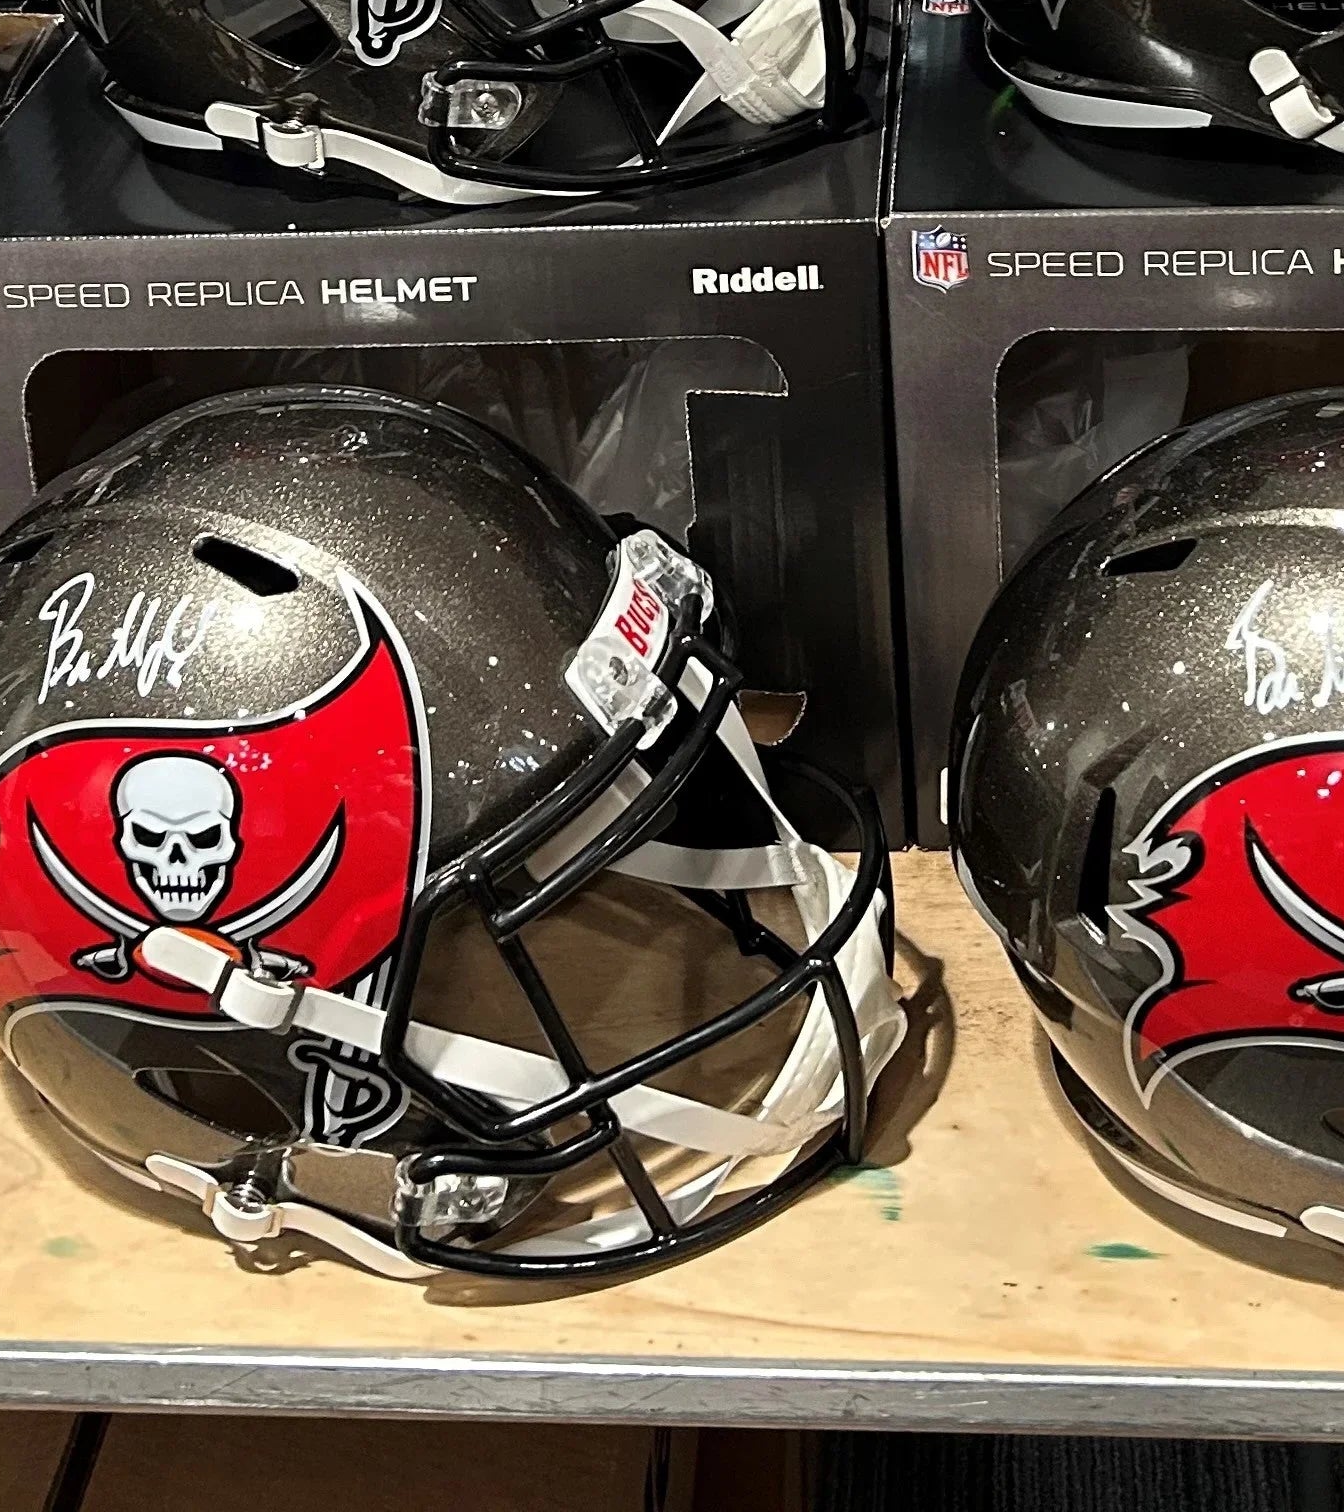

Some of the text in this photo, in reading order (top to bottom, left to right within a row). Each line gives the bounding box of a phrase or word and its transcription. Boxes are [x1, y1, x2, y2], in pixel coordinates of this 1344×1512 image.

[923, 251, 968, 281] NFL
[987, 251, 1124, 277] SPEED
[1143, 249, 1314, 277] REPLICA
[3, 276, 478, 309] SPEED REPLICA HELMET
[692, 264, 824, 295] Riddell
[614, 577, 663, 658] BUCS
